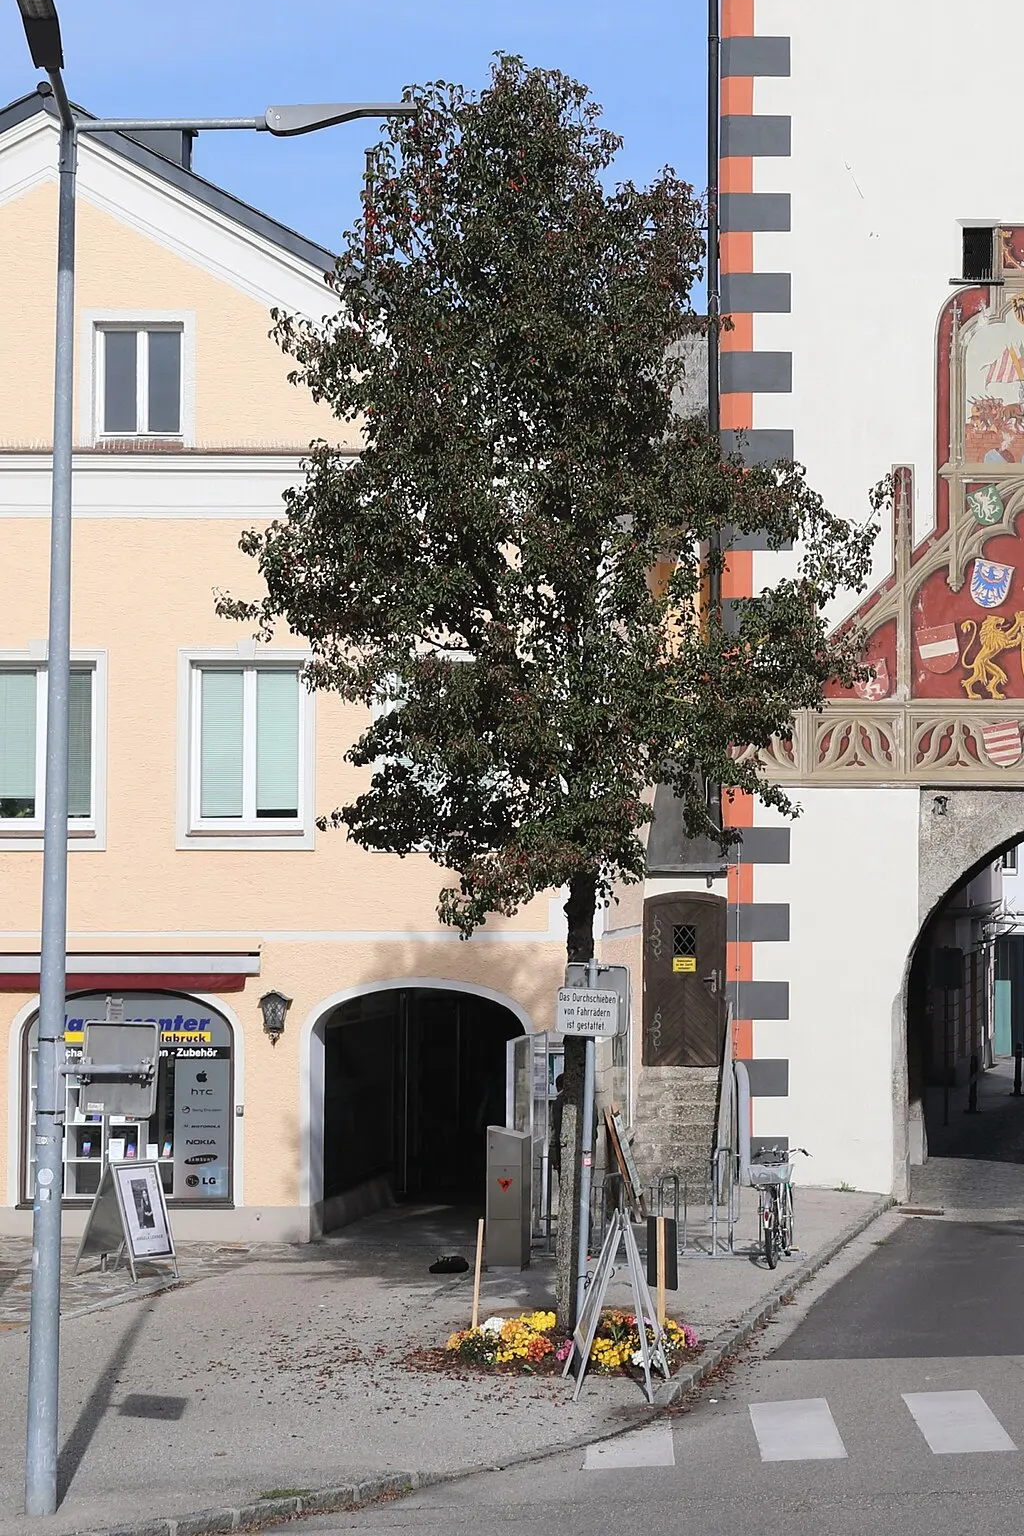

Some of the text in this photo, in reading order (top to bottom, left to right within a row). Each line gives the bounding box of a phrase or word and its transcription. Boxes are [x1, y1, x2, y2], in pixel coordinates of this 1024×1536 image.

[559, 992, 616, 1004] Das Durchschieben
[564, 1007, 611, 1017] von Fahrrädern
[566, 1020, 575, 1029] ist
[176, 1047, 218, 1057] Zubehör
[202, 1177, 216, 1185] LG
